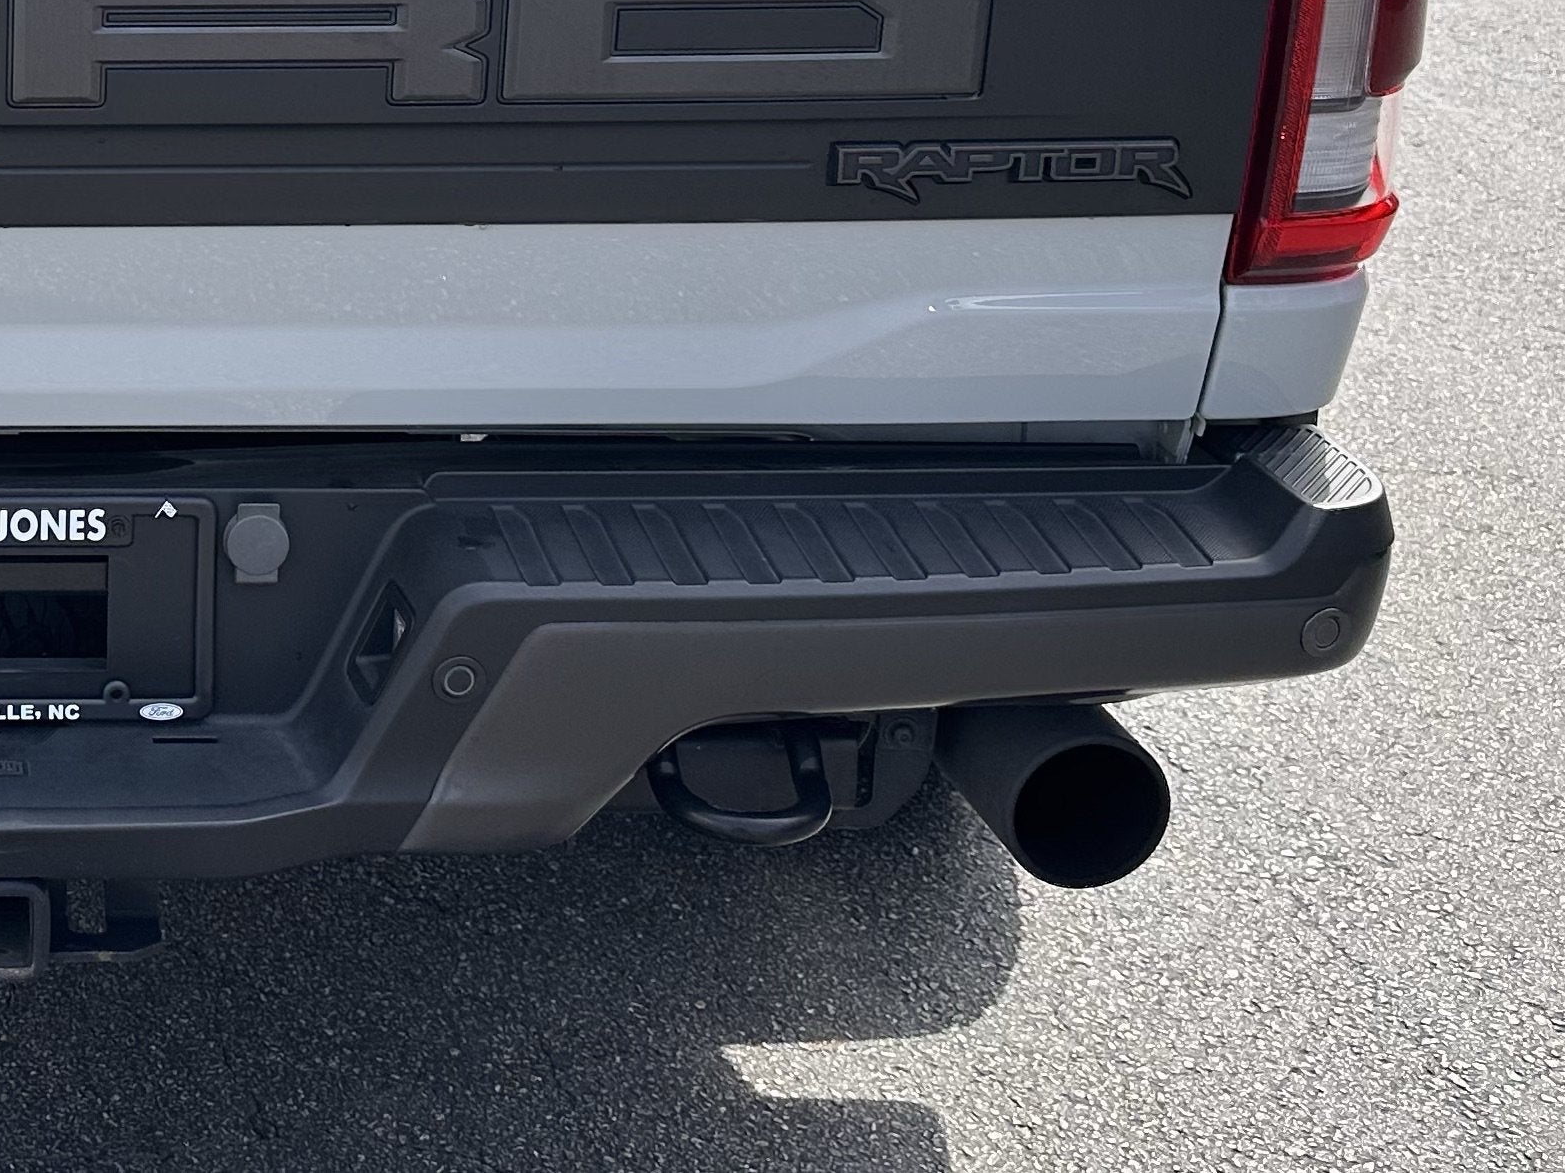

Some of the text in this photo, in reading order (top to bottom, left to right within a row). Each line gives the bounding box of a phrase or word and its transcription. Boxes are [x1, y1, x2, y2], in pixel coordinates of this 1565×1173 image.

[827, 136, 1192, 204] RAPTOR
[47, 704, 81, 721] NC
[148, 706, 174, 716] Ford
